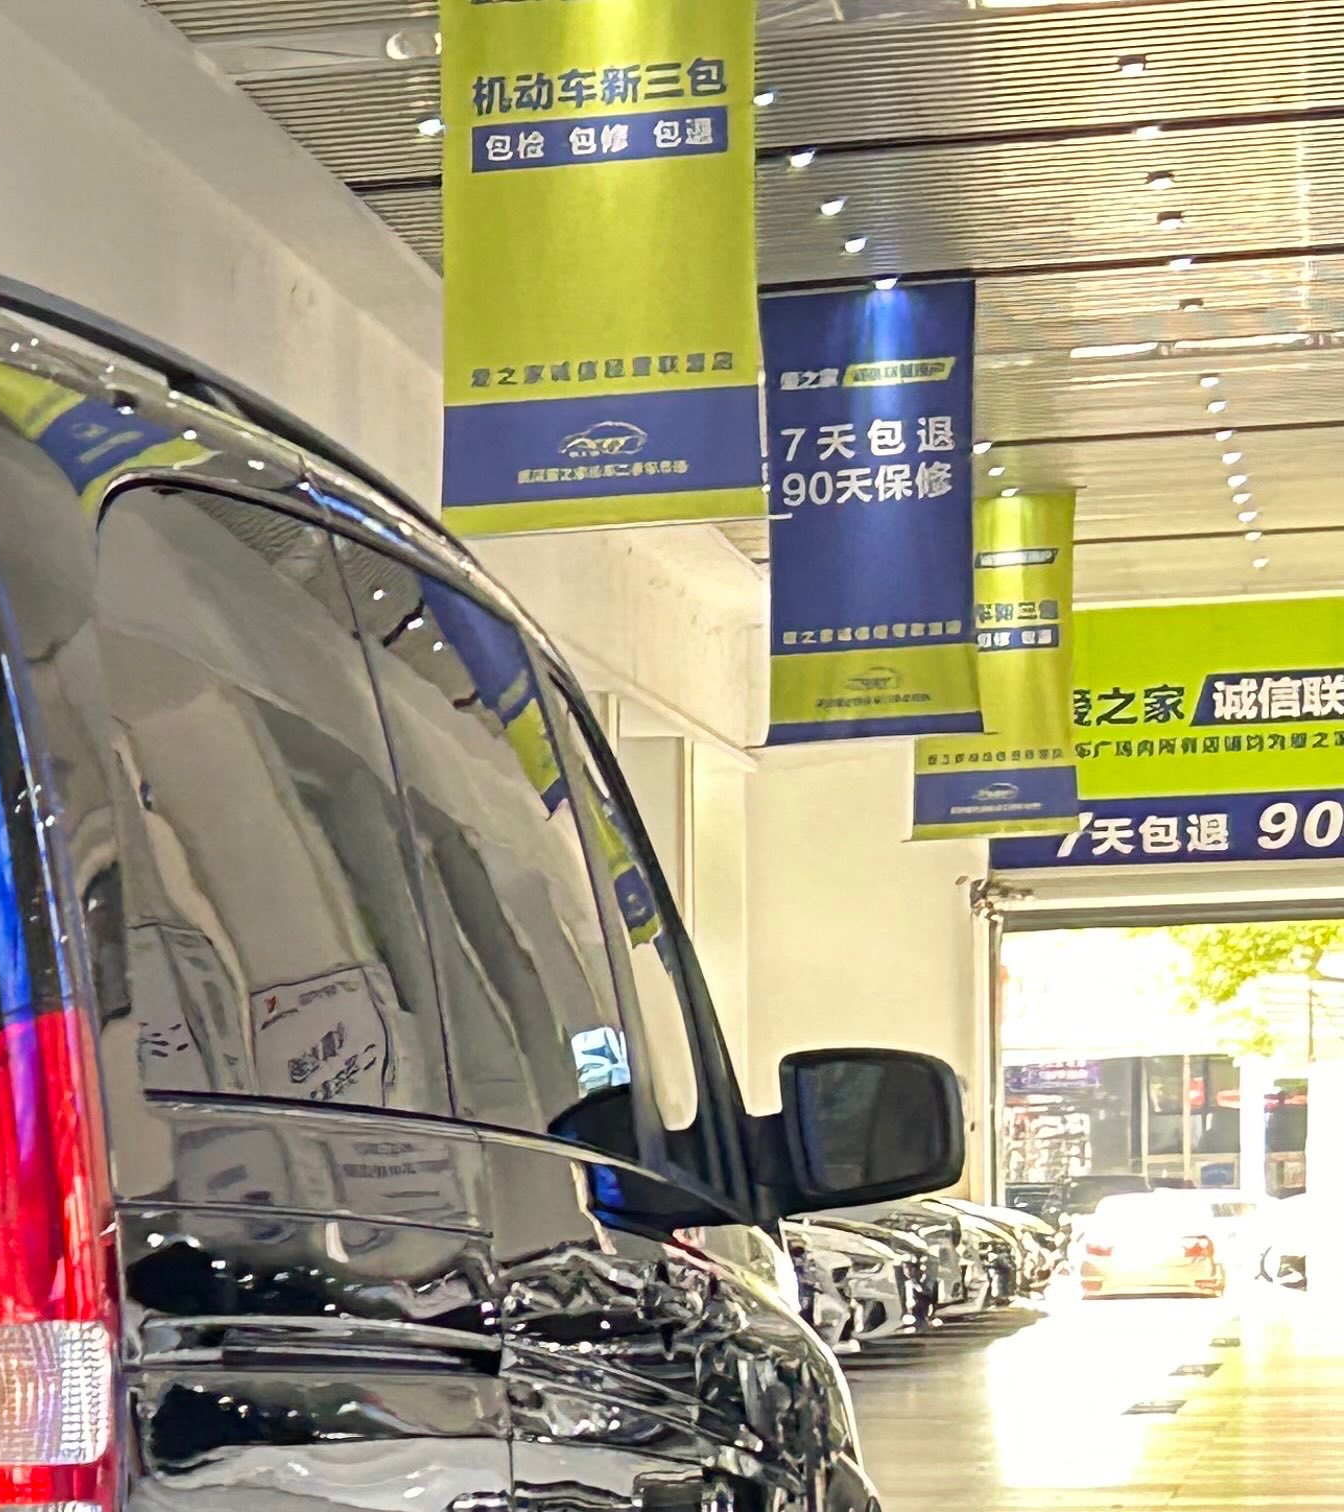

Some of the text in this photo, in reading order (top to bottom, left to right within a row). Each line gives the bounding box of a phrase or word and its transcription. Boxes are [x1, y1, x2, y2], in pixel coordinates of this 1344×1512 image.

[472, 57, 727, 116] 机动车新三包
[782, 461, 953, 506] 90天保修
